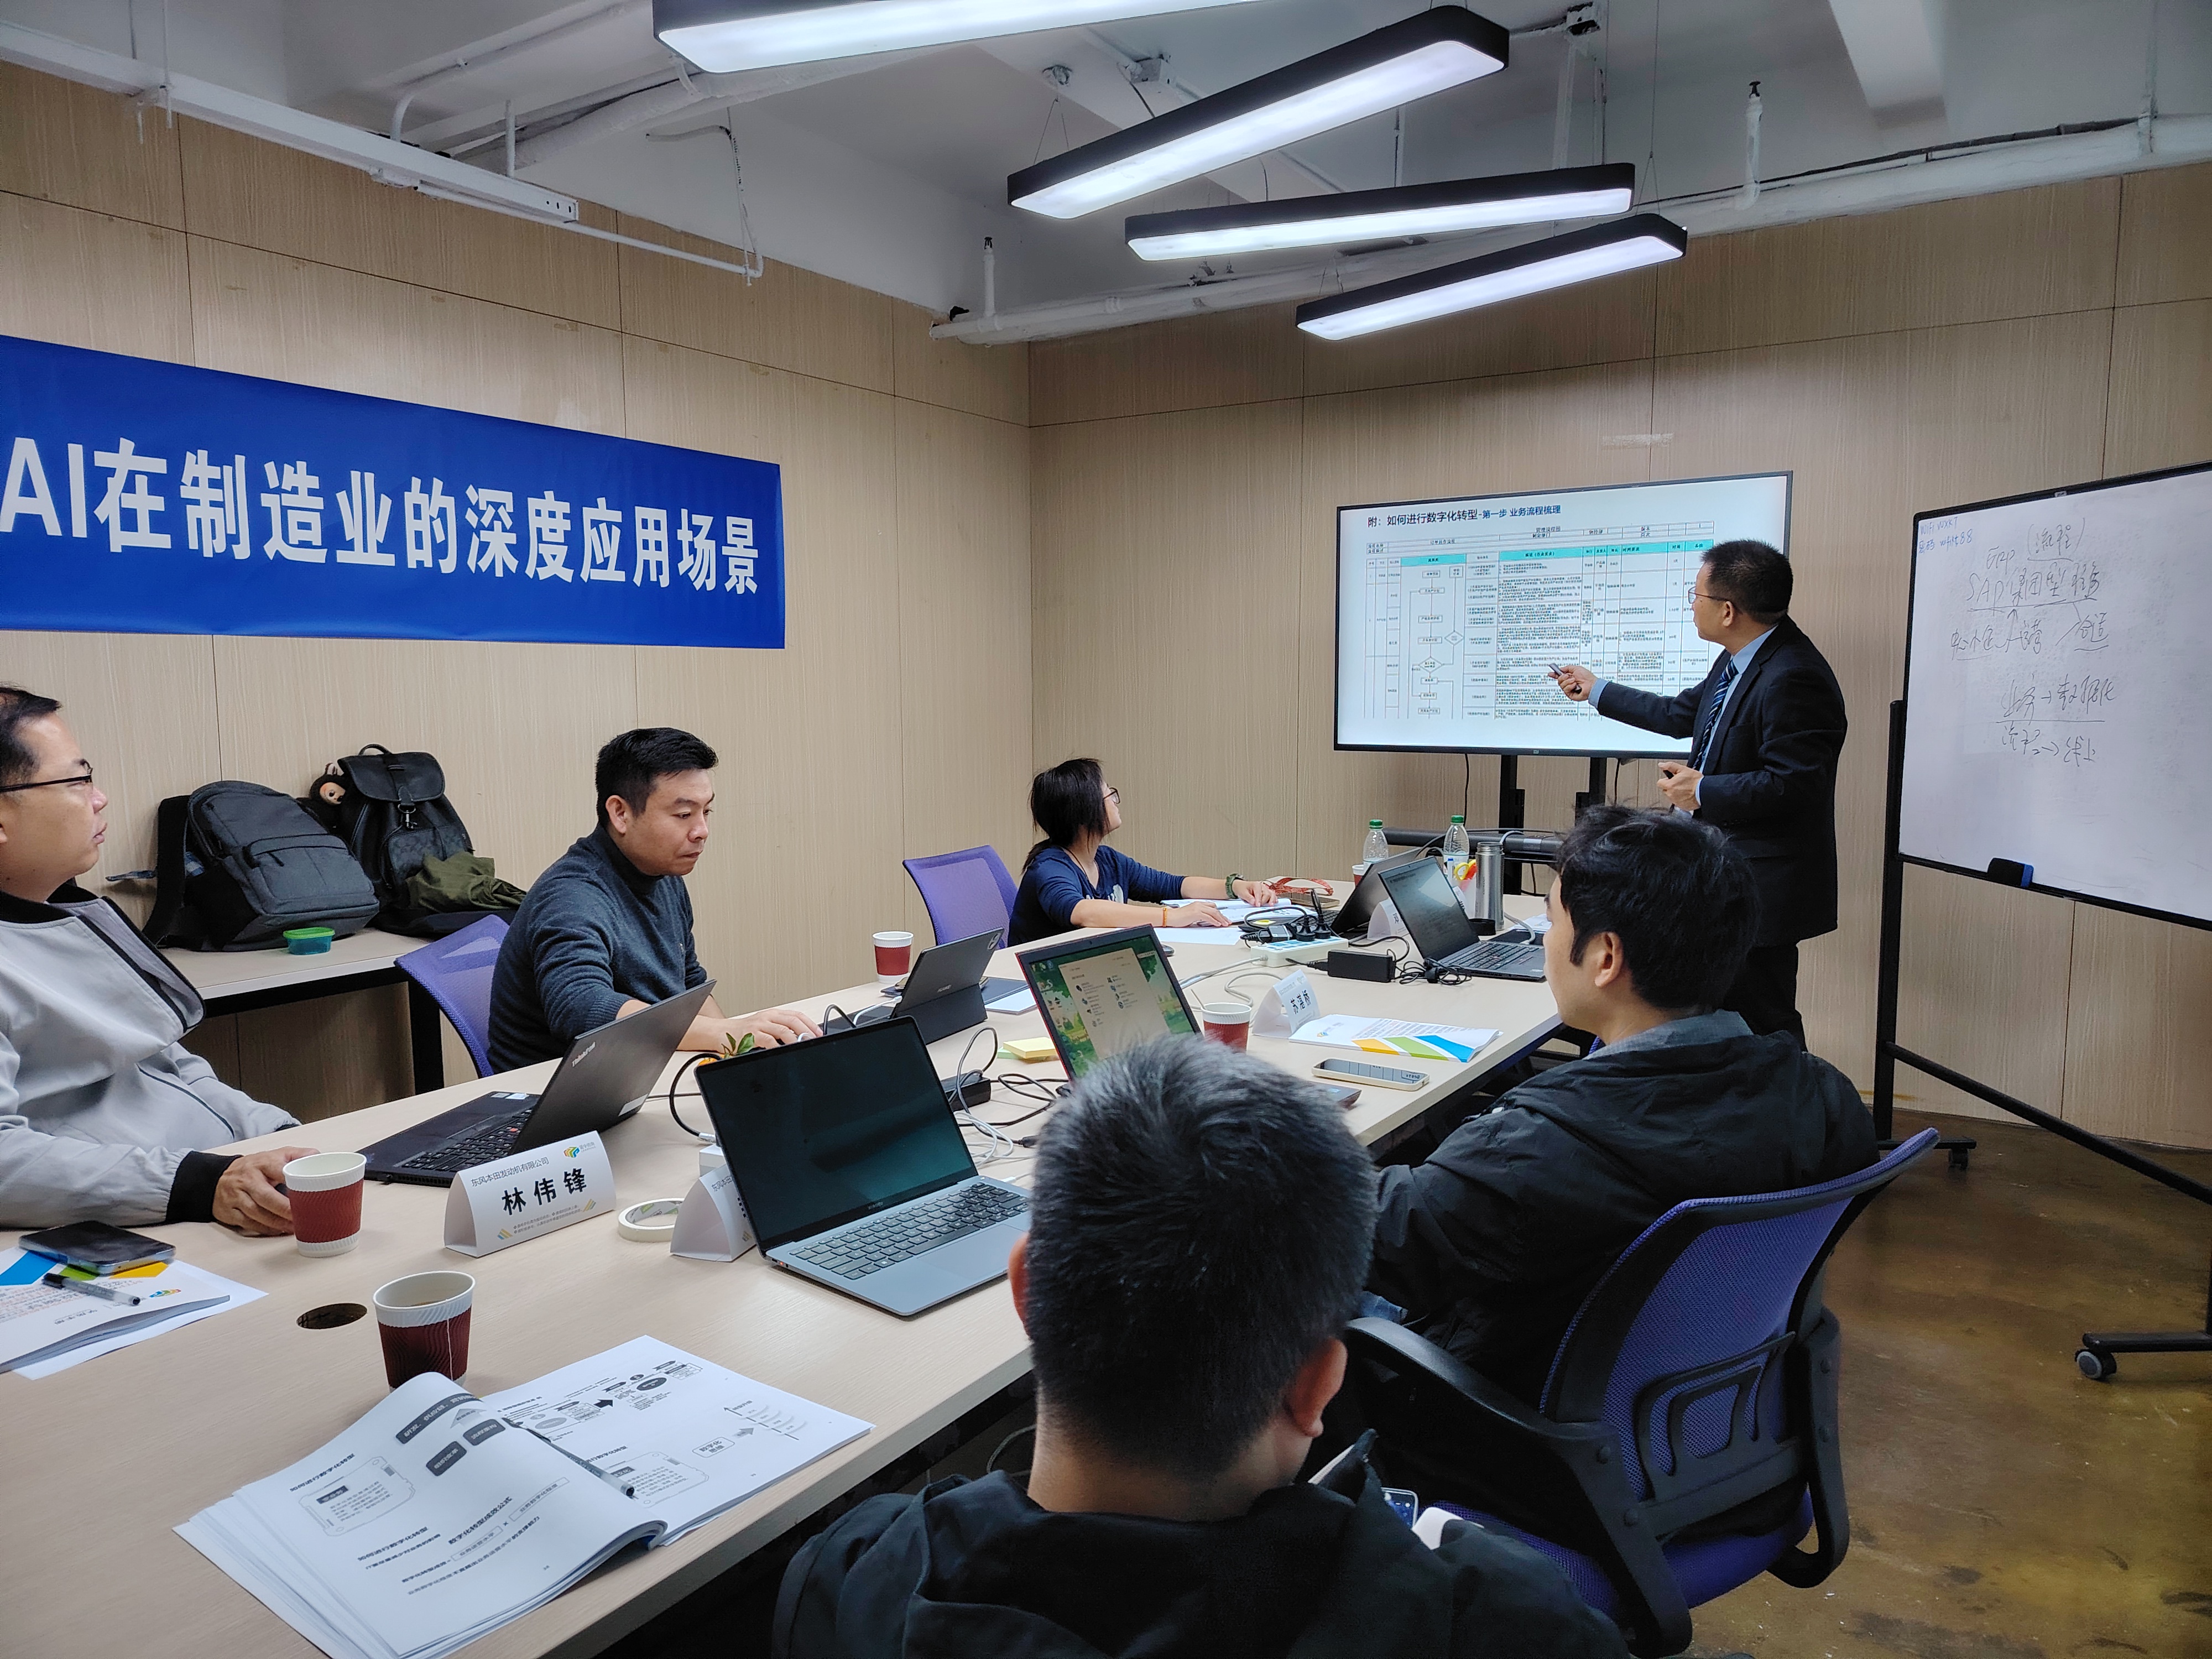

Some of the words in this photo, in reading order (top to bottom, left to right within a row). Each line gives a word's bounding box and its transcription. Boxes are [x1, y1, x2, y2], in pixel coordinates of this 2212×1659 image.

[0, 436, 759, 594] AI在制造业的深度应用场景
[1509, 505, 1561, 517] 业务流程梳理
[471, 1156, 550, 1187] 东风本田发动机有限公司
[501, 1167, 587, 1216] 林伟锋
[289, 1453, 356, 1492] 如何进行数字化转型
[357, 1526, 428, 1561] 如何进行数字化转型
